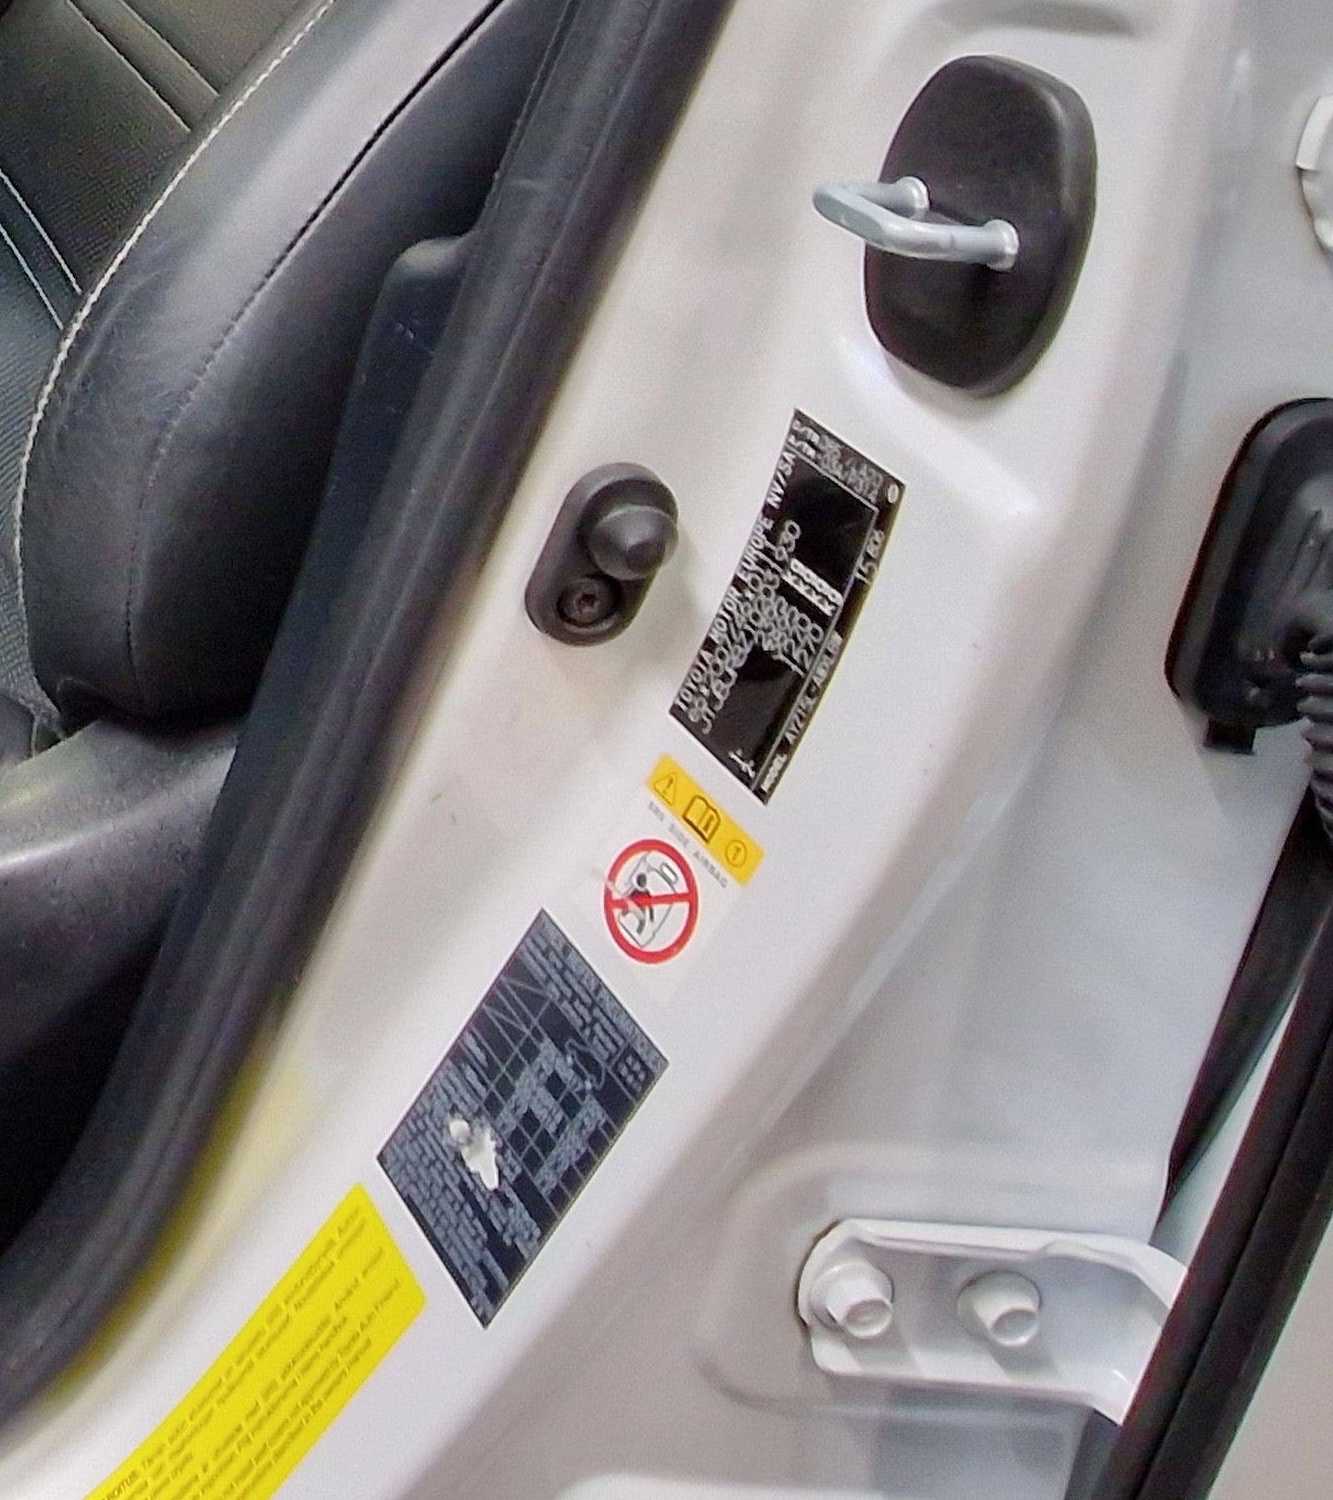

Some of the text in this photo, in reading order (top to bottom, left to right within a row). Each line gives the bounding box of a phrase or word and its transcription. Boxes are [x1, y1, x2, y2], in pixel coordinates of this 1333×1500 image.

[674, 446, 797, 713] TOYOTA MOTOR EUROPE NV/SA
